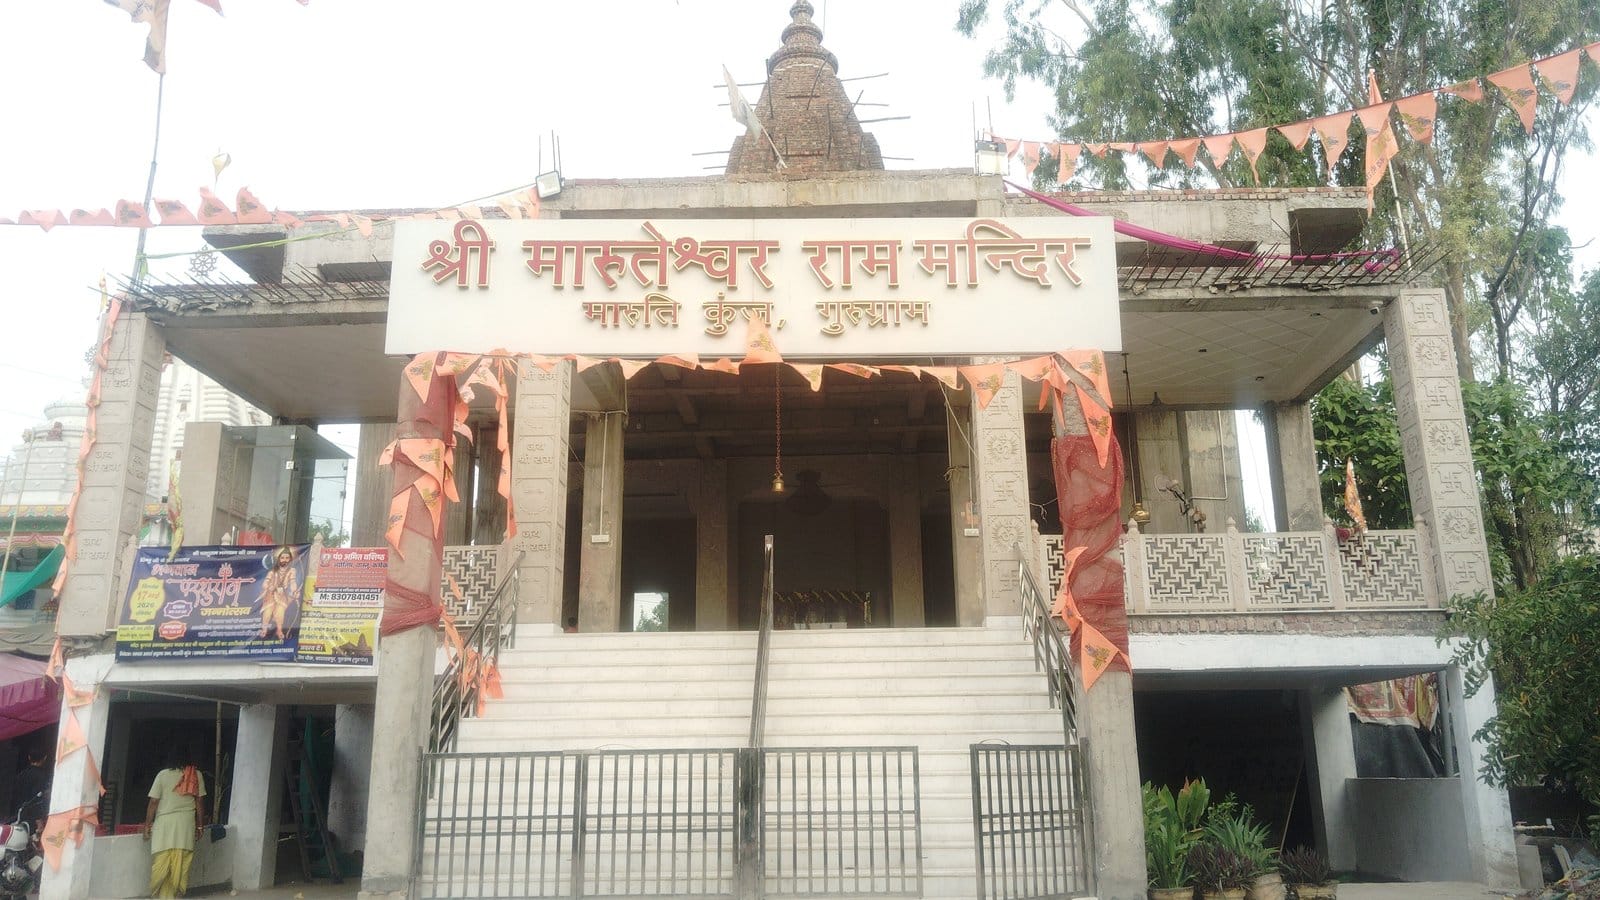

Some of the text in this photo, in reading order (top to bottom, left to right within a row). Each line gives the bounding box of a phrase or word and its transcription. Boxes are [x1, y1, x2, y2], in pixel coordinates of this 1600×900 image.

[421, 219, 1092, 289] श्री मारुतेश्वर राम मन्दिर
[582, 292, 682, 328] मारुति
[815, 299, 931, 335] गुरुग्राम
